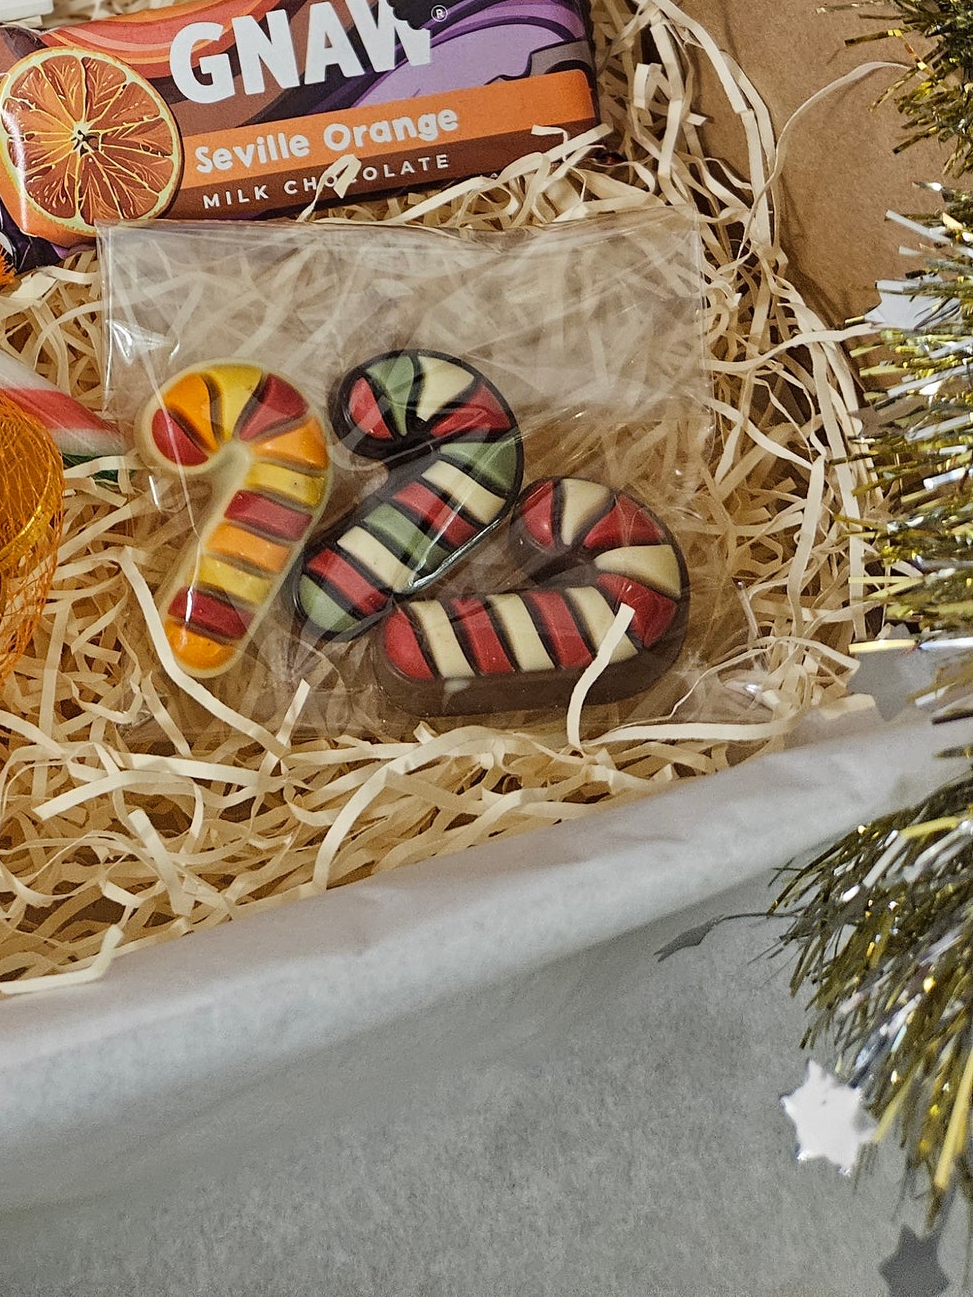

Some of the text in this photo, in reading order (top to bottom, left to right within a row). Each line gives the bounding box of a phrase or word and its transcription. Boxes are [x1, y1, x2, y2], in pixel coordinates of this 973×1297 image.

[194, 109, 459, 174] Seville Orange
[202, 154, 450, 210] MILK CHOOLATE
